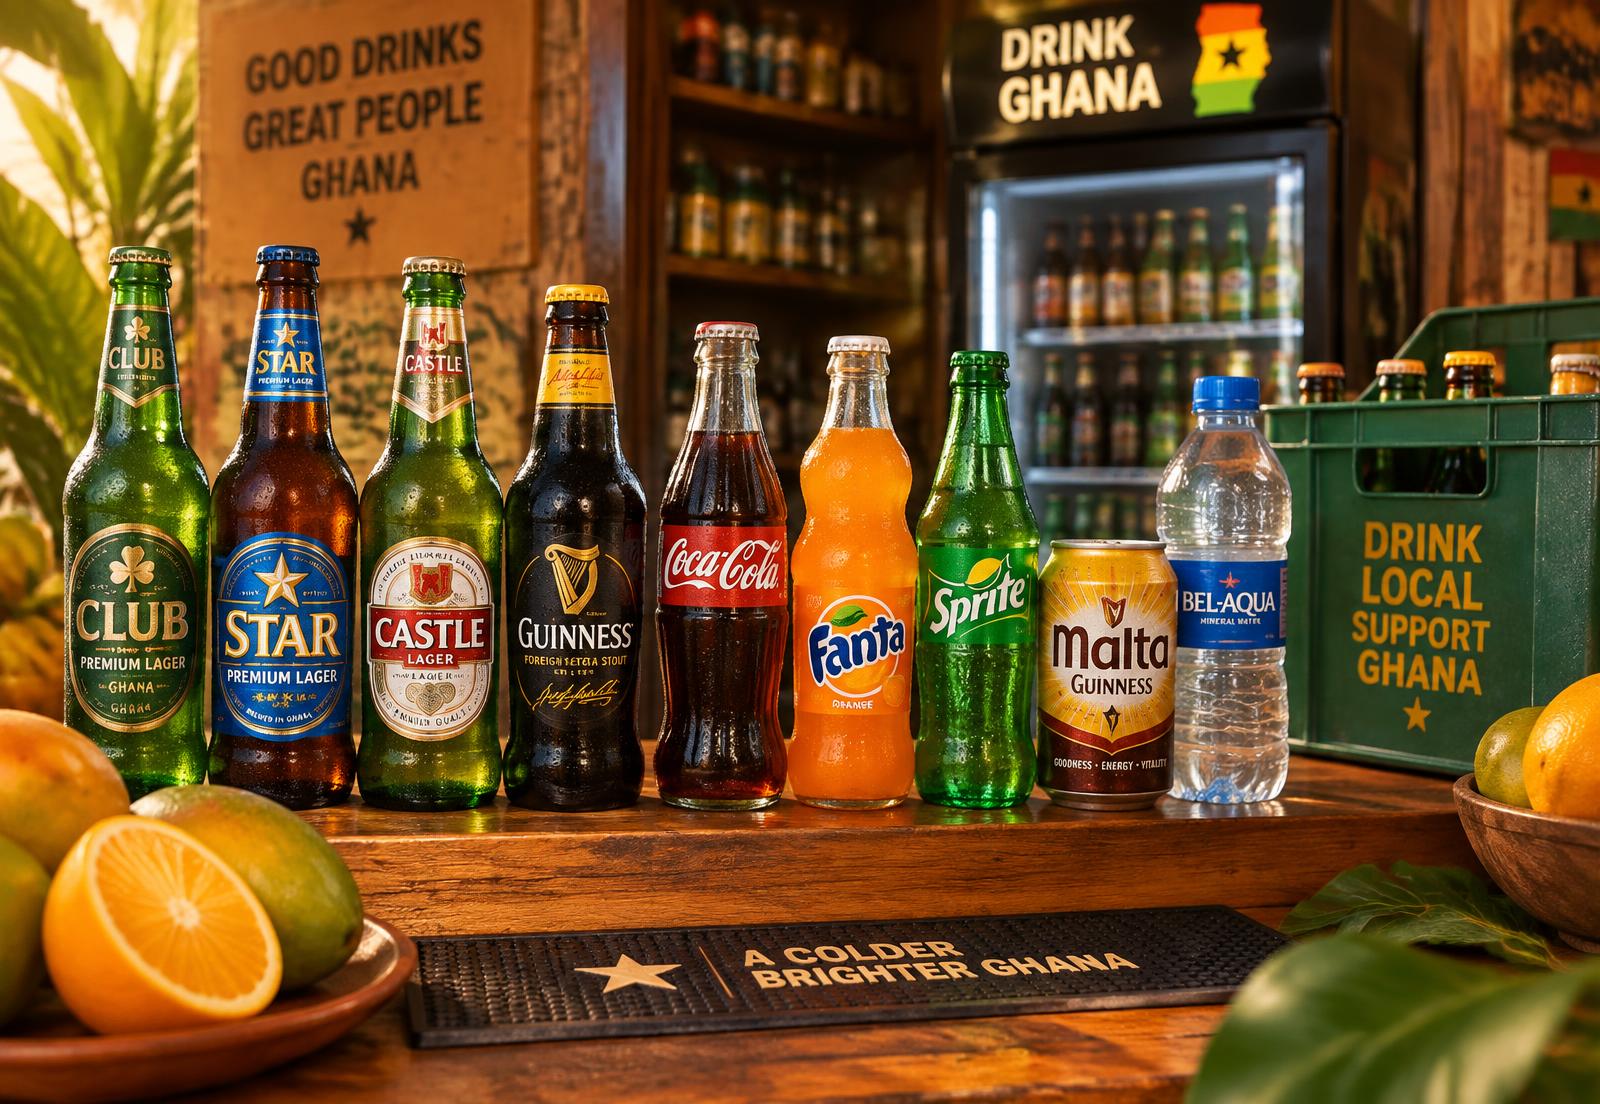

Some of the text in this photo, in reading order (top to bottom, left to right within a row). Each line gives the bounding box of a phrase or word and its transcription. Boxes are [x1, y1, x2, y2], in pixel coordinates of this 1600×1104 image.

[245, 19, 483, 93] GOOD DRINKS
[1001, 14, 1135, 72] DRINK
[999, 62, 1162, 124] GHANA
[243, 82, 483, 152] GREAT PEOPLE
[302, 150, 419, 201] GHANA
[109, 347, 165, 370] CLUB
[256, 350, 317, 375] STAR
[405, 354, 463, 373] CASTLE
[1363, 521, 1483, 563] DRINK
[664, 538, 783, 590] Coca-Cola
[929, 569, 1025, 638] Sprite
[1182, 591, 1276, 616] BEL-AQUA
[1362, 565, 1483, 611] LOCAL
[76, 599, 189, 642] CLUB
[225, 609, 341, 658] STAR
[375, 617, 485, 649] CASTLE
[518, 617, 633, 650] GUINNESS
[1352, 610, 1491, 653] SUPPORT
[80, 656, 186, 671] PREMIUM LAGER
[408, 653, 454, 665] LAGER
[524, 655, 562, 667] FOREIGN
[601, 655, 628, 667] STOUT
[808, 615, 905, 686] Fanta
[1053, 624, 1169, 670] Malta
[108, 681, 154, 694] GHANA
[227, 669, 337, 684] PREMIUM LAGER
[1071, 674, 1153, 695] GUINNESS
[1357, 649, 1482, 696] GHANA
[1101, 761, 1134, 771] ENERGY
[744, 941, 964, 967] A COLDER
[751, 952, 1140, 989] BRIGHTER GHANA
